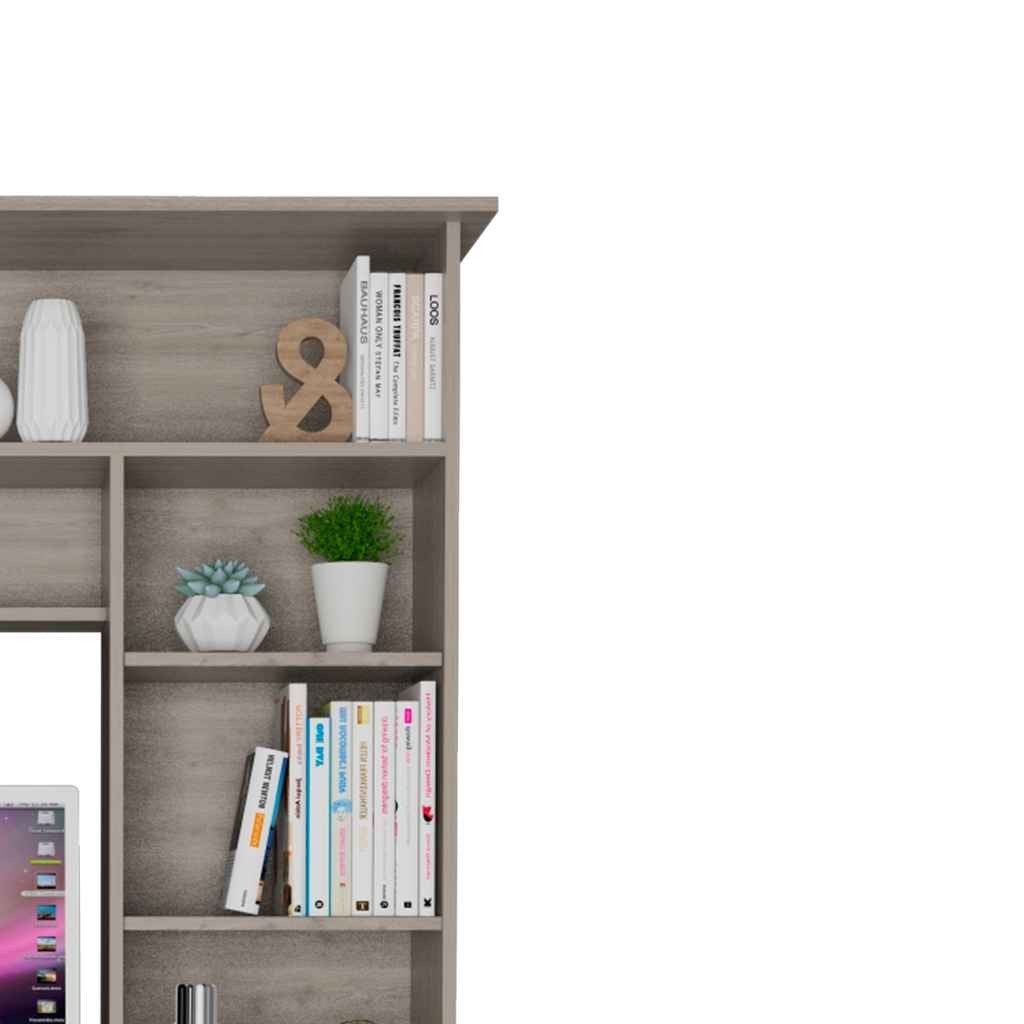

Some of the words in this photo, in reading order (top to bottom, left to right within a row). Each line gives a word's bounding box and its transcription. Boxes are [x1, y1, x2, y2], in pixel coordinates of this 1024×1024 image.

[359, 280, 369, 344] BAUHAUS
[375, 289, 384, 324] WOMAN
[429, 294, 439, 326] LOOS
[375, 326, 384, 349] ONLY
